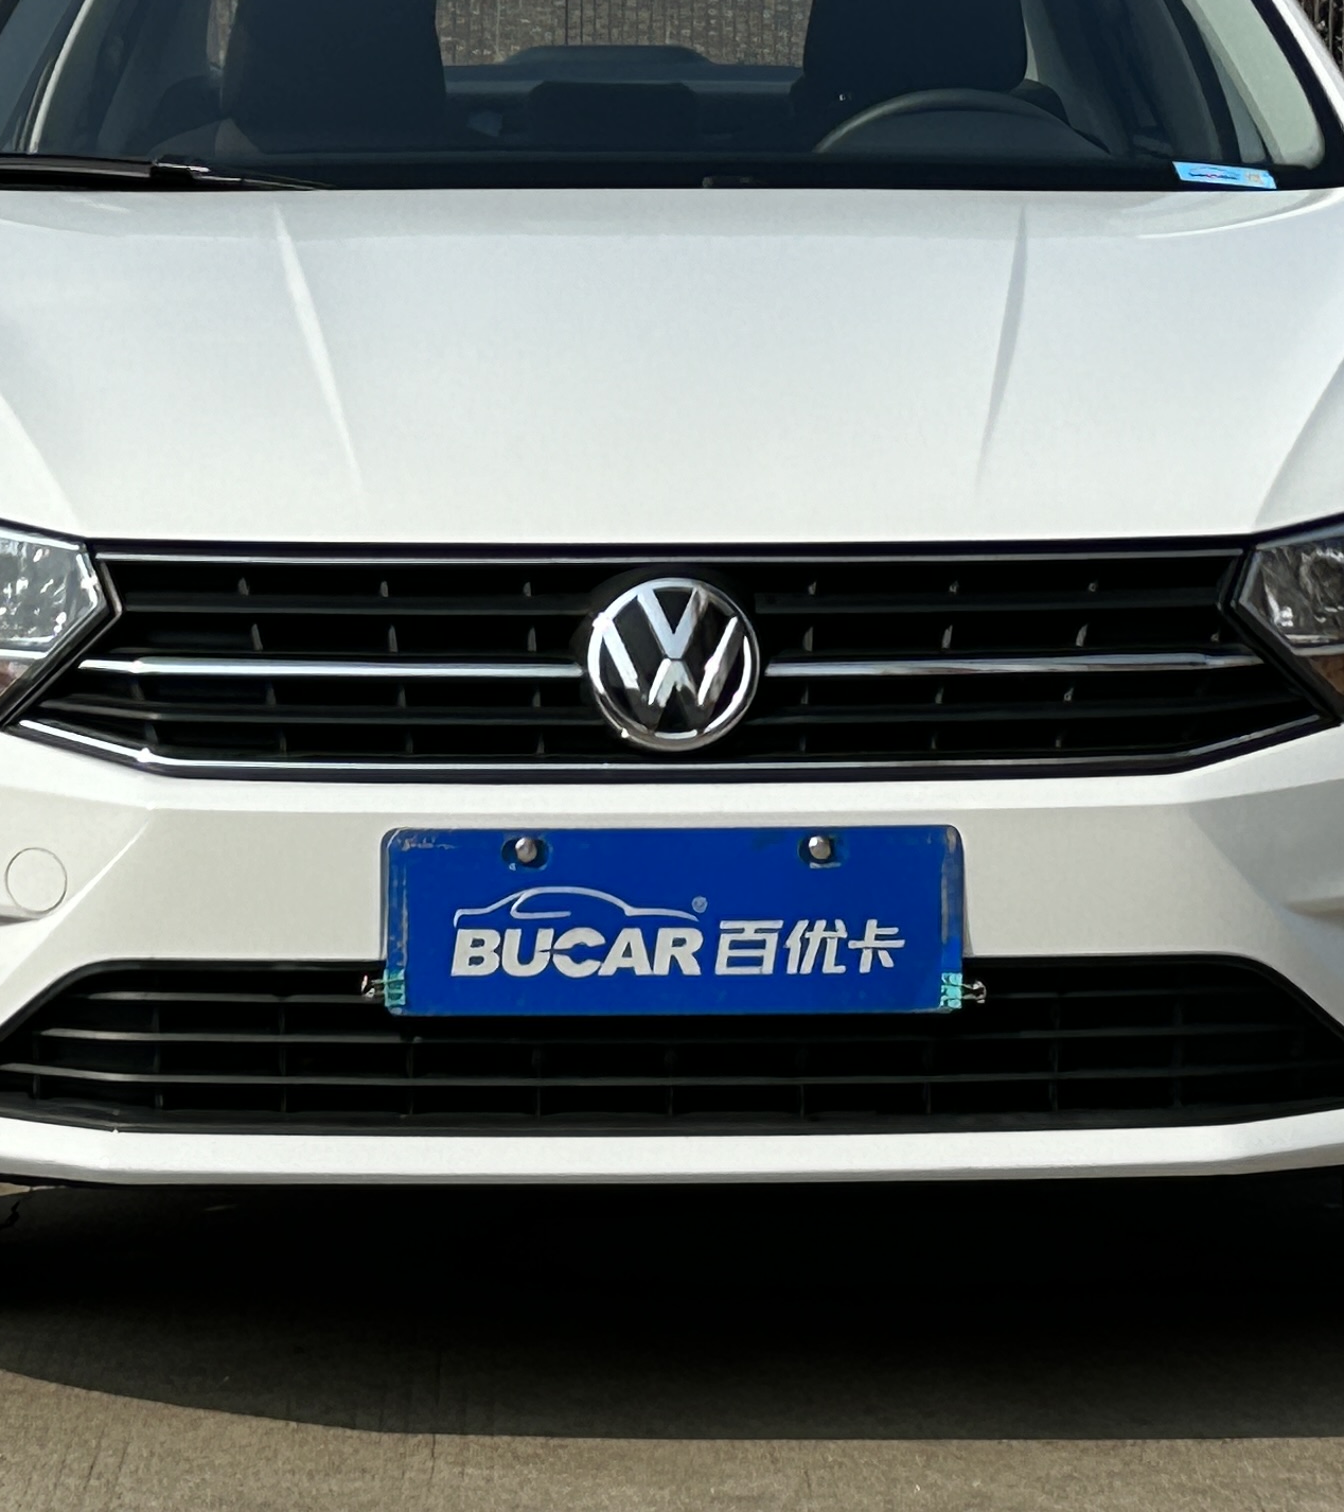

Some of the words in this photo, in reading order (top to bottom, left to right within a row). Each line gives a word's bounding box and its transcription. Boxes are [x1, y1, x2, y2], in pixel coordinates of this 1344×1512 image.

[594, 582, 754, 742] VW
[452, 926, 703, 978] BUCAR
[715, 919, 906, 976] 百优卡
